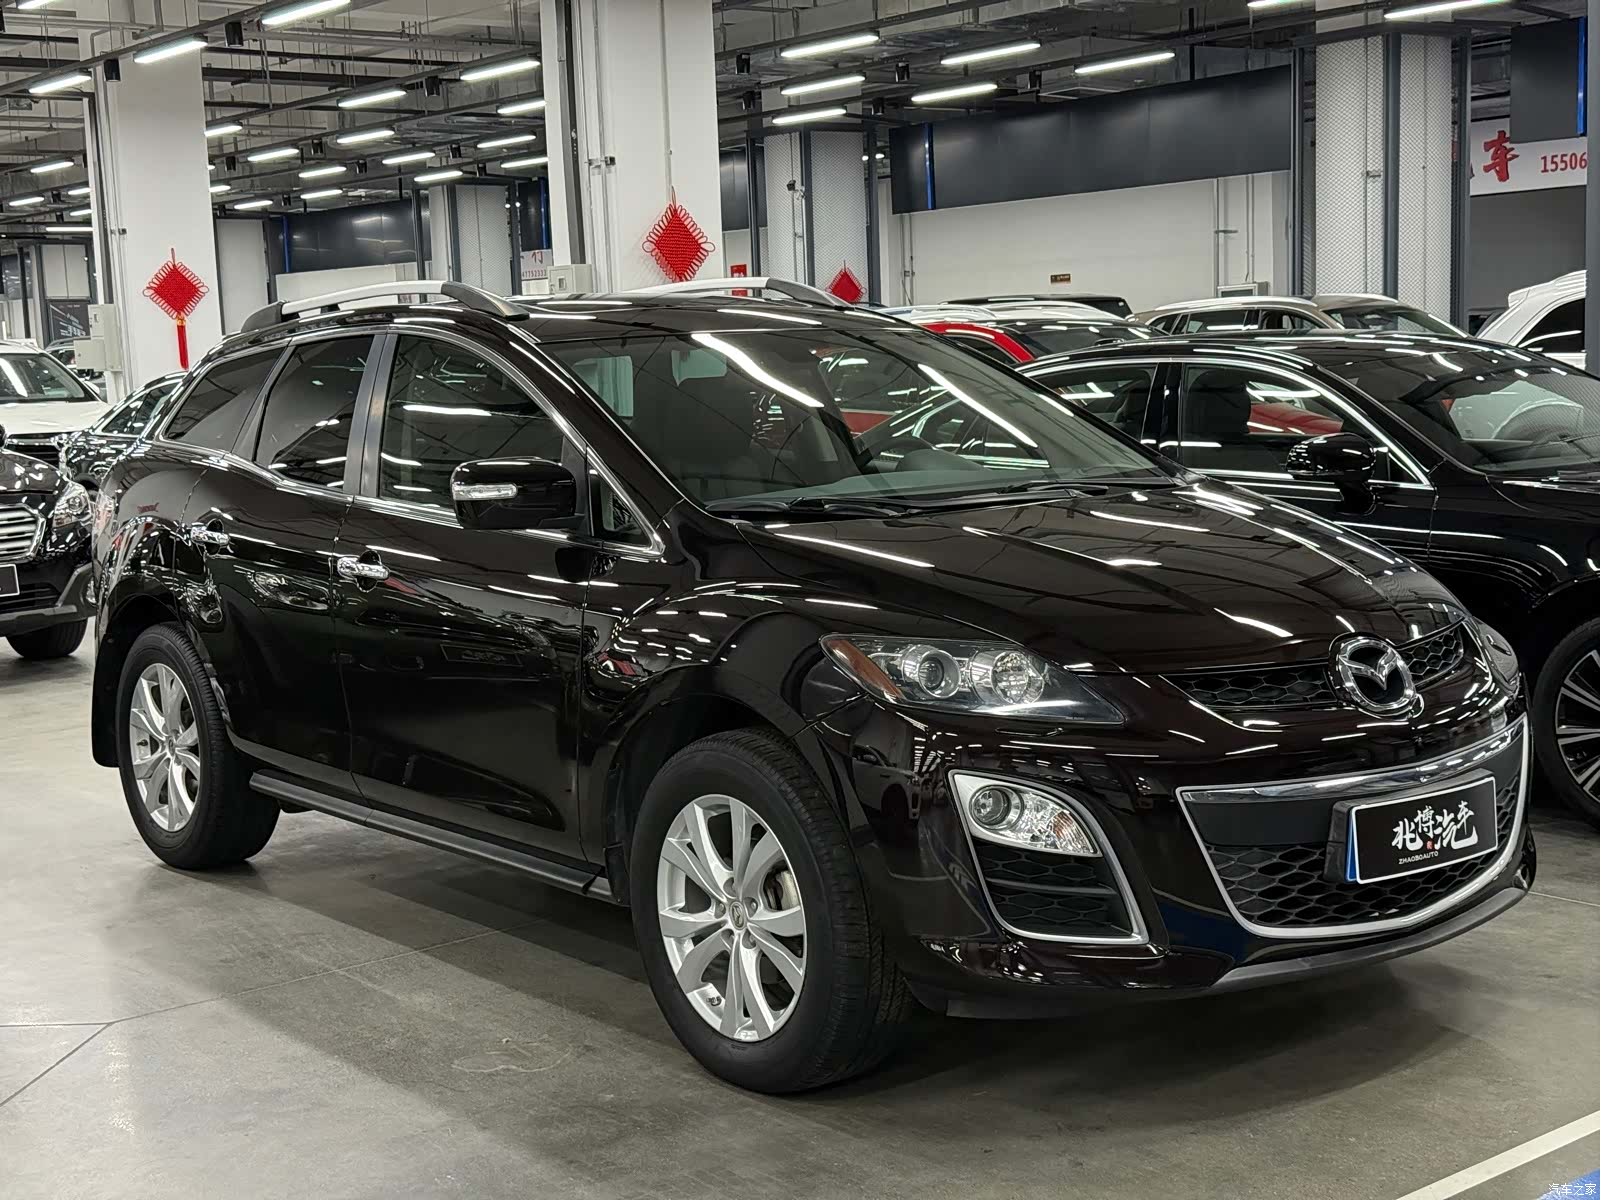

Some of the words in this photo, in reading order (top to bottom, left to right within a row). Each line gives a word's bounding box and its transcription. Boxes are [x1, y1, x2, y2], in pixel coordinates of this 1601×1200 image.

[1470, 130, 1520, 182] 车
[1541, 152, 1588, 173] 15506
[1398, 851, 1439, 865] ZHAOBOAUTO
